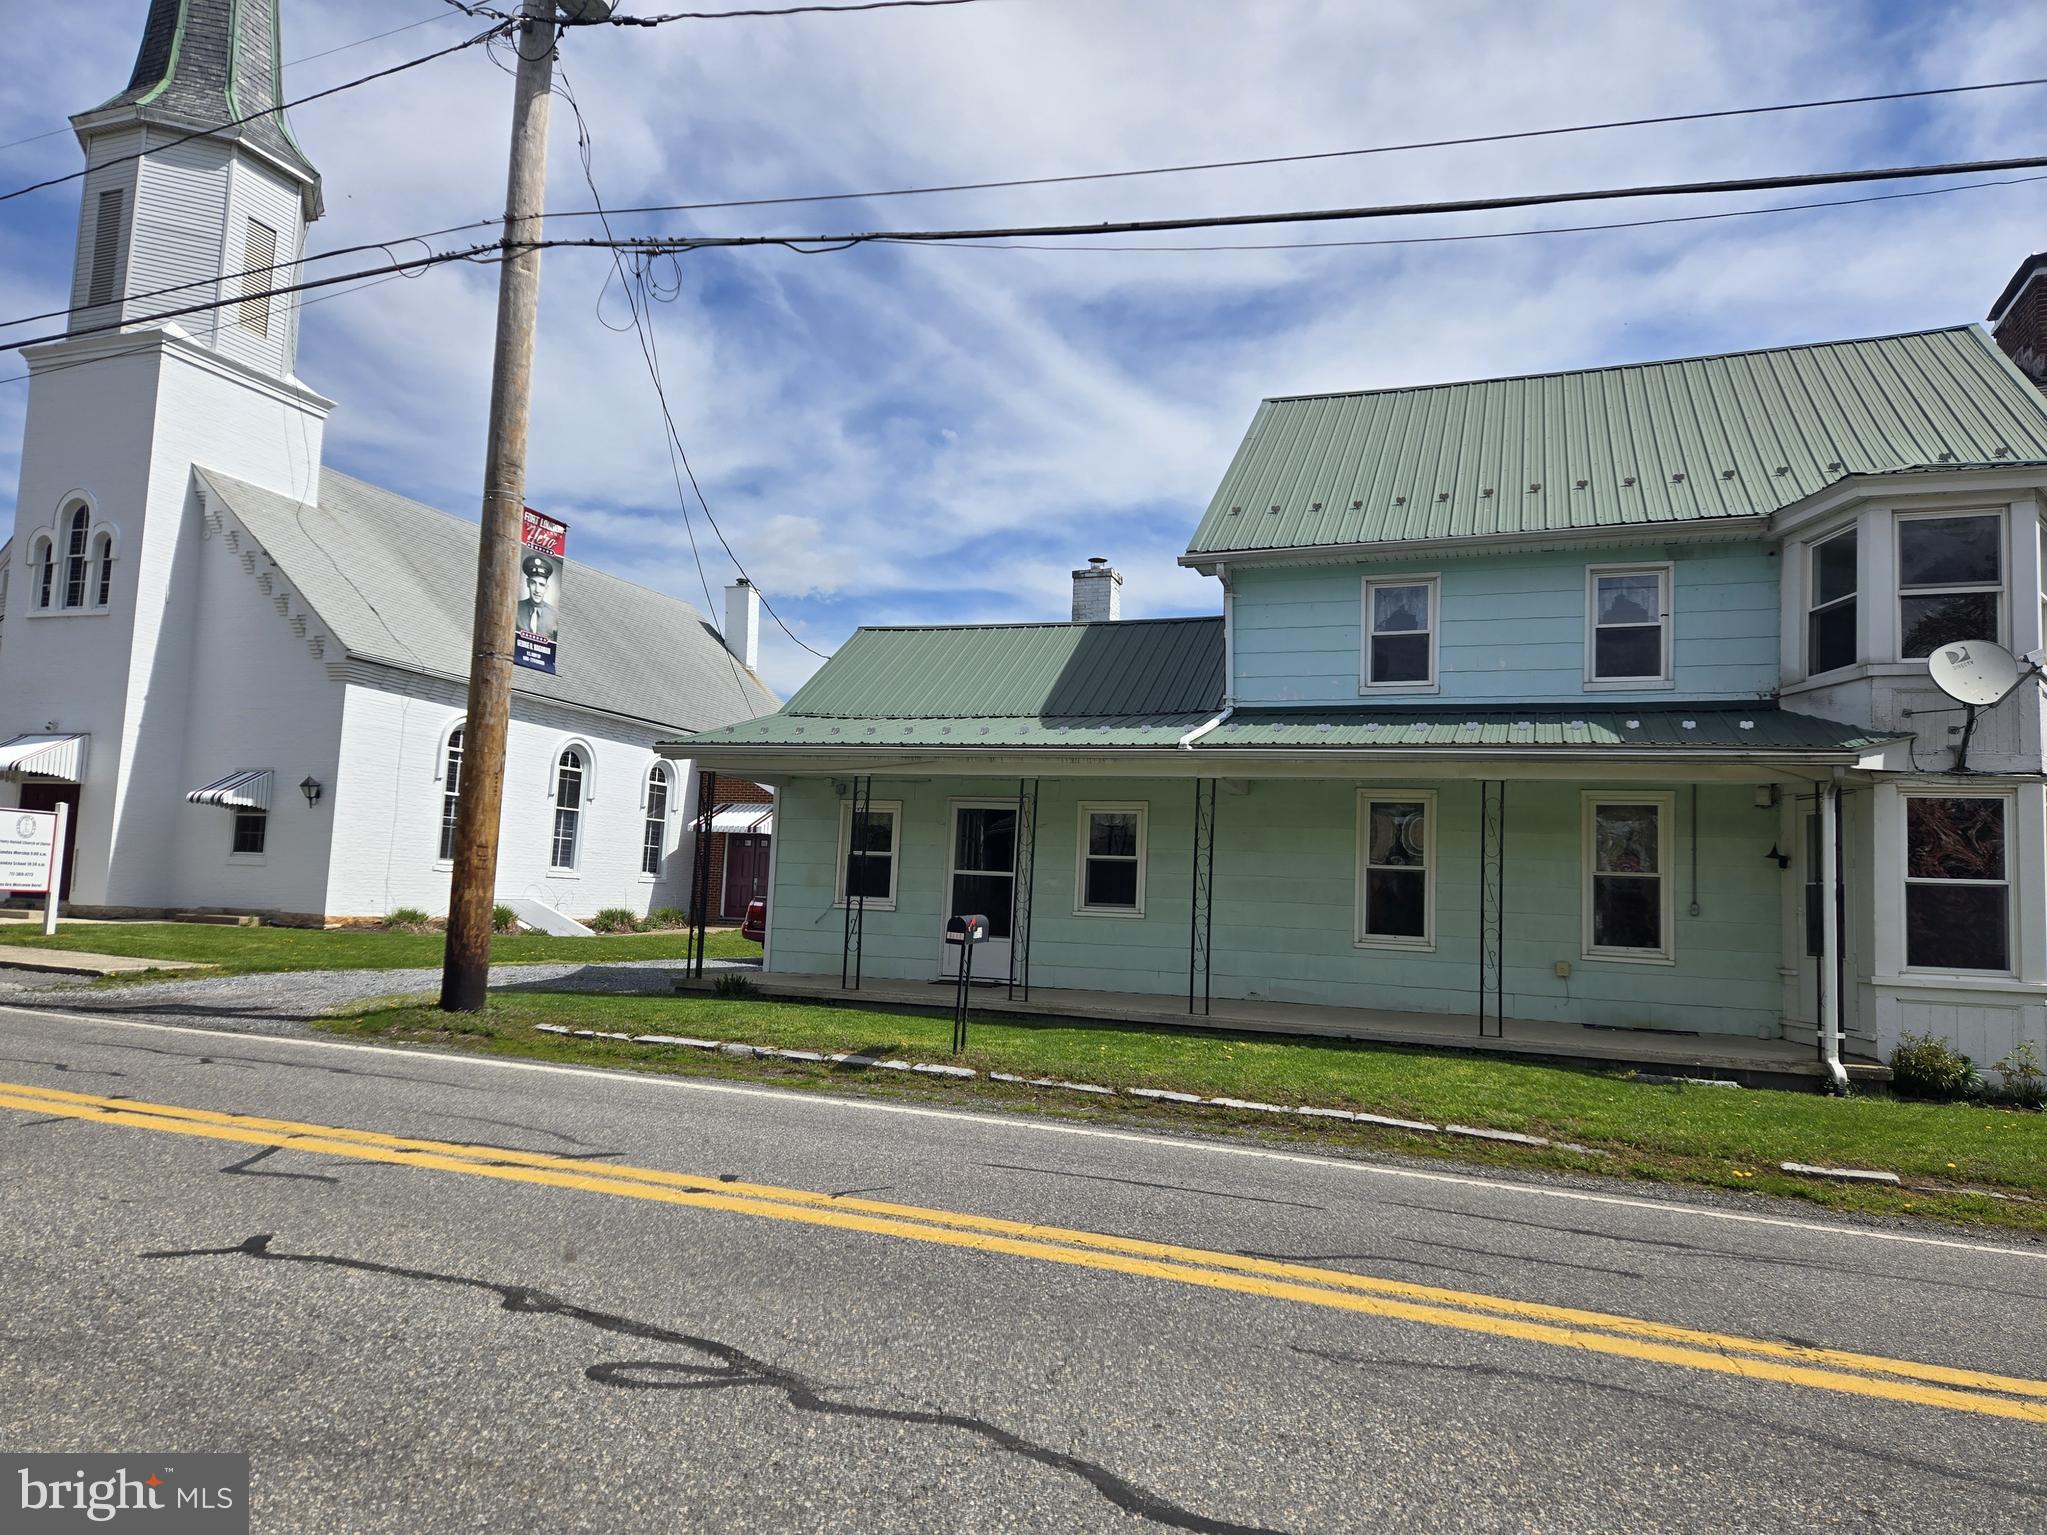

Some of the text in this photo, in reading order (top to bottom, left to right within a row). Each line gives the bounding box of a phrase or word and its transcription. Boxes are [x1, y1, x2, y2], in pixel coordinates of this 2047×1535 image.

[524, 511, 541, 526] FORT
[526, 525, 558, 549] Hero
[1952, 660, 1975, 670] DIRECTV
